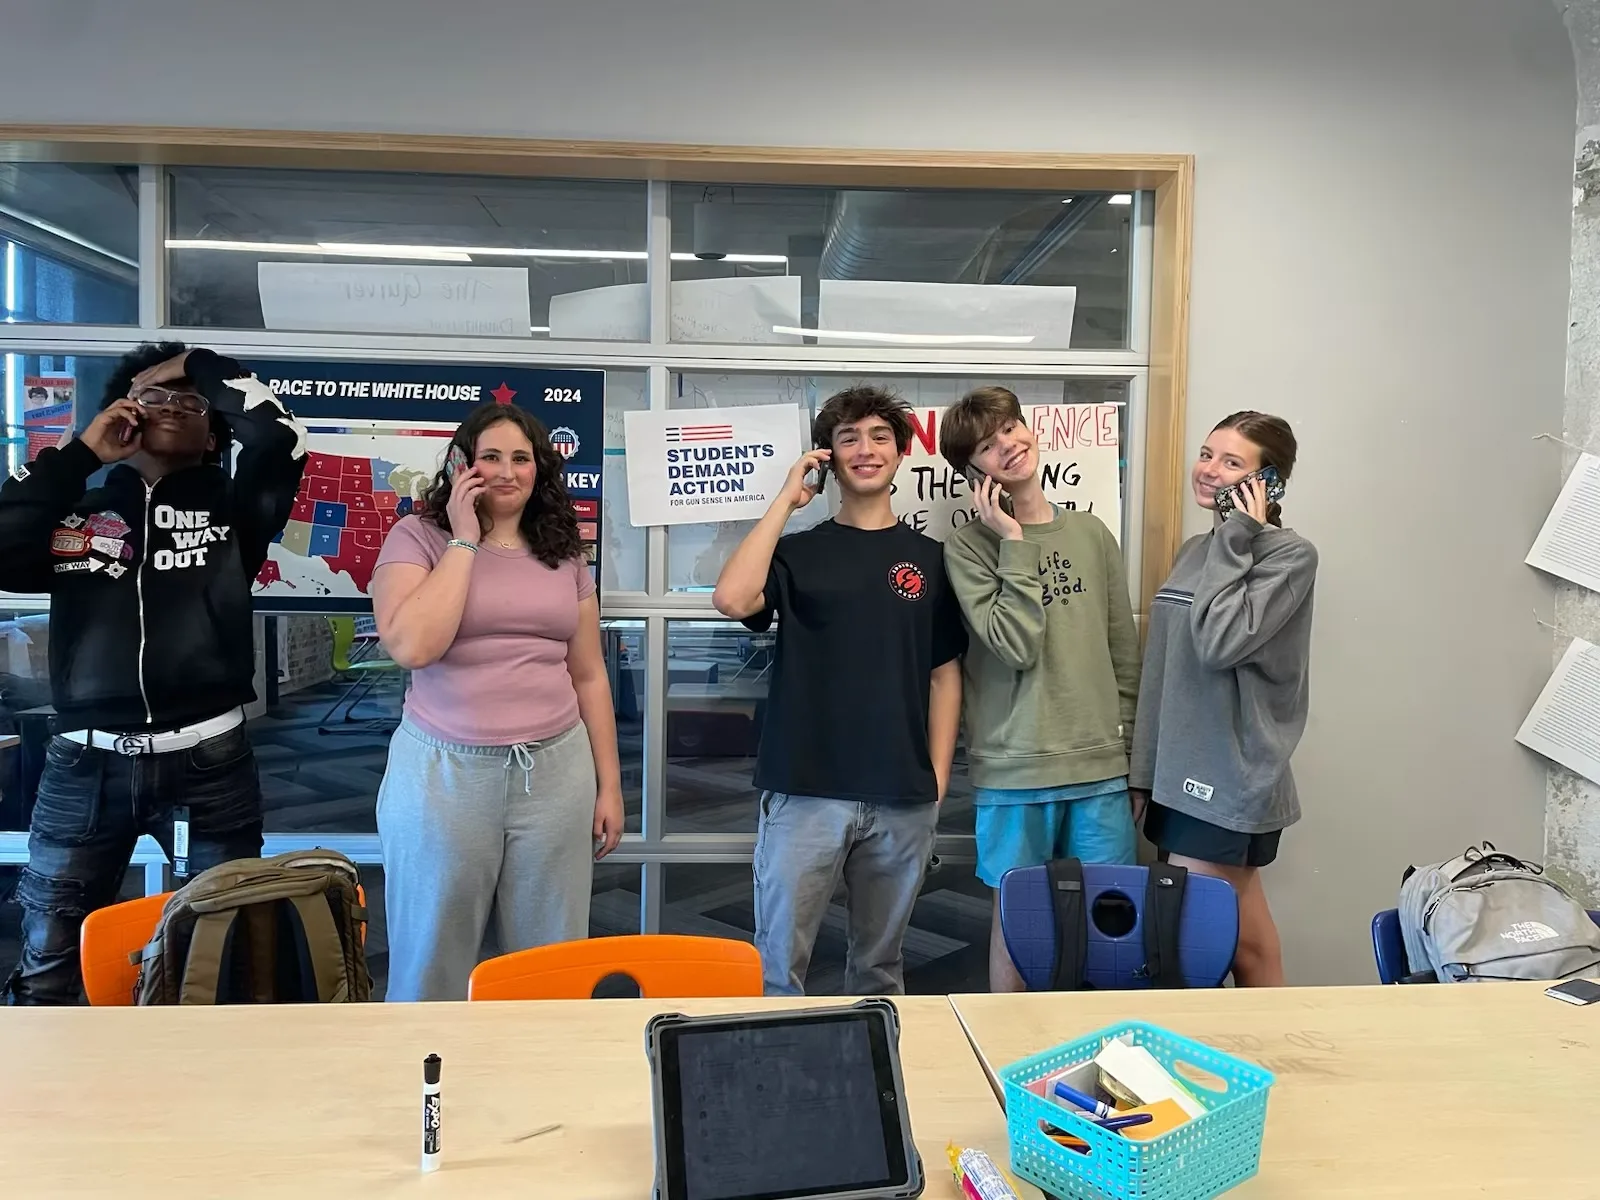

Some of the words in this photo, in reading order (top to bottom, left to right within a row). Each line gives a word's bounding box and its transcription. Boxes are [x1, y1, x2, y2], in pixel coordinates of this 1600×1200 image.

[269, 379, 313, 396] RACE
[314, 380, 338, 396] TO
[338, 381, 370, 398] THE
[371, 382, 425, 399] WHITE
[424, 384, 481, 401] HOUSE
[544, 388, 581, 403] 2024
[1033, 405, 1117, 452] ENCE
[667, 444, 774, 462] STUDENTS
[668, 462, 755, 479] DEMAND
[567, 473, 600, 489] KEY
[669, 478, 745, 496] ACTION
[911, 467, 965, 501] THE
[670, 499, 684, 507] FOR
[686, 498, 700, 506] GUN
[701, 496, 723, 505] SENSE
[733, 493, 766, 503] AMERICA
[154, 505, 210, 529] ONE
[171, 526, 230, 549] WAY
[154, 547, 209, 571] OUT
[1038, 551, 1071, 575] Life
[1053, 572, 1068, 584] is
[1500, 928, 1537, 939] NORTH
[1511, 922, 1533, 930] THE
[426, 1096, 440, 1128] EXPO
